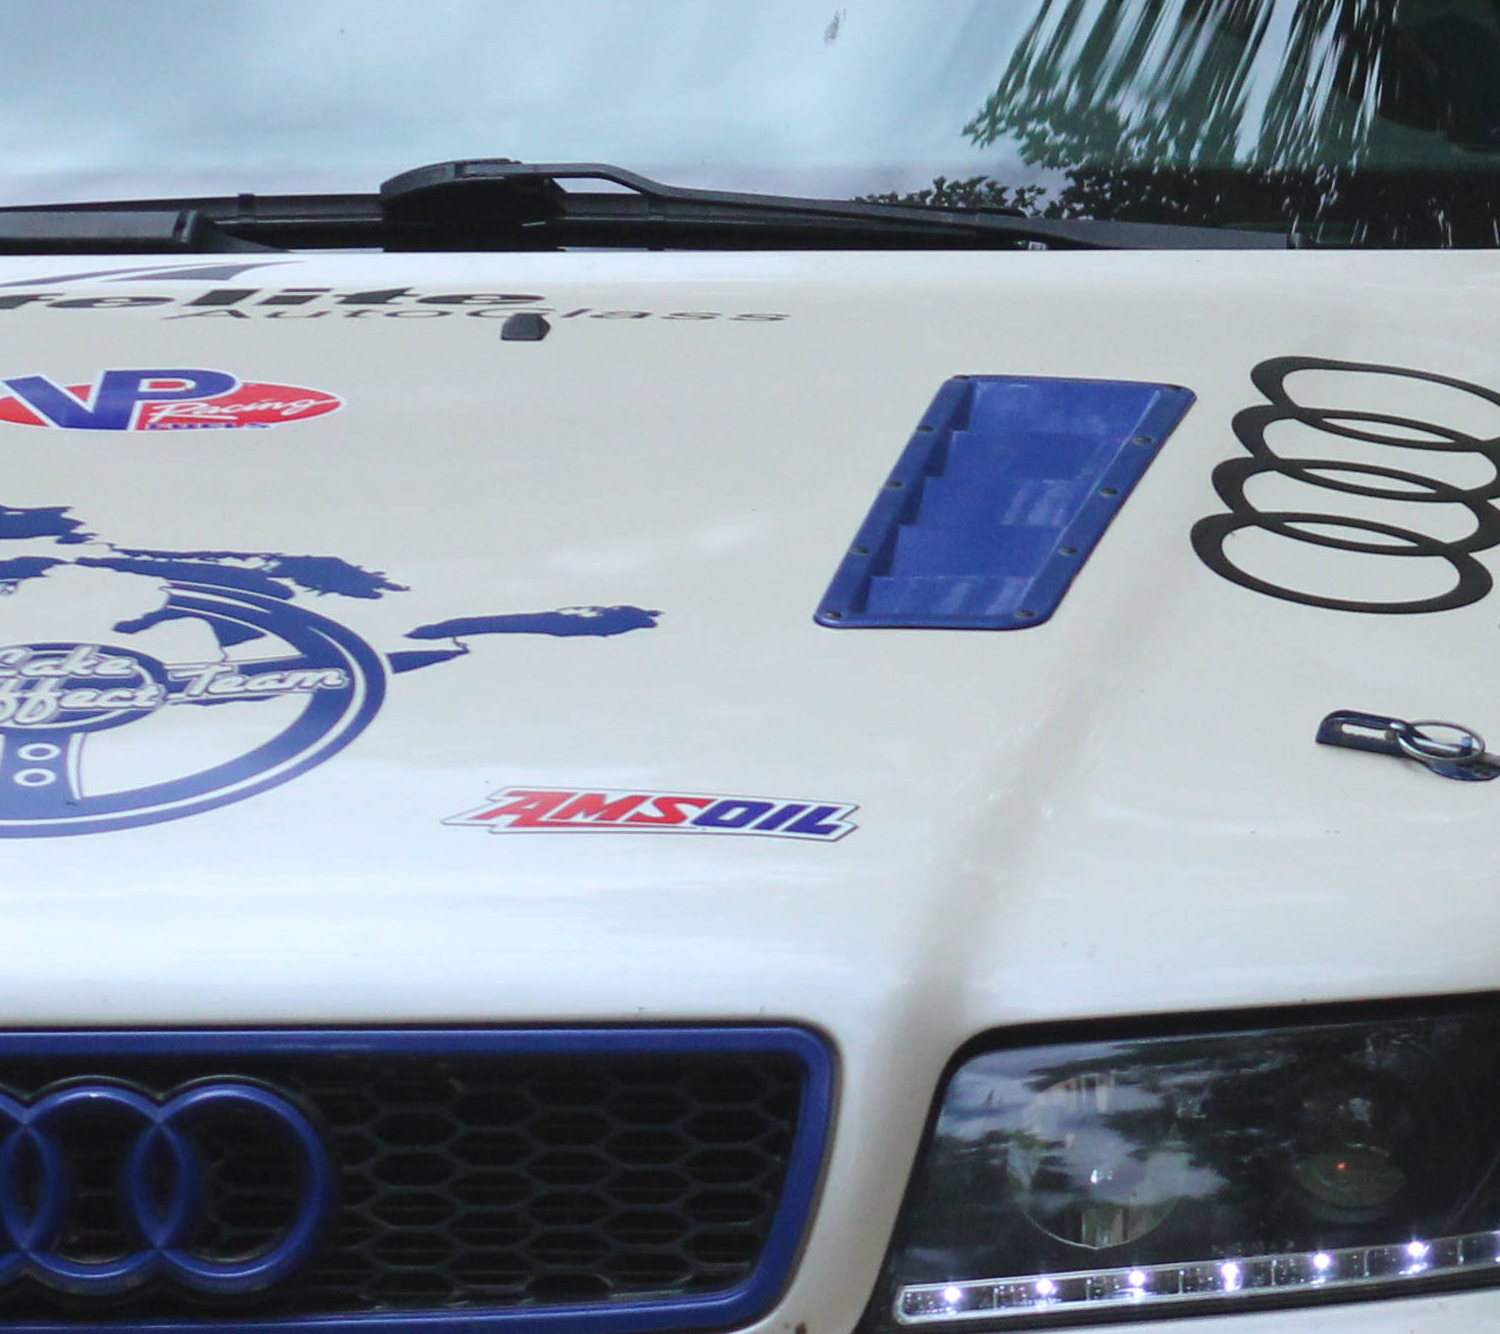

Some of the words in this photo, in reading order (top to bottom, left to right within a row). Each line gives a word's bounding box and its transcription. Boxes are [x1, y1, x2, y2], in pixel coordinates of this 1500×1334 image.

[1, 369, 237, 431] VP
[147, 397, 340, 424] Racing
[166, 666, 348, 704] Team
[469, 789, 844, 836] AMSOIL
